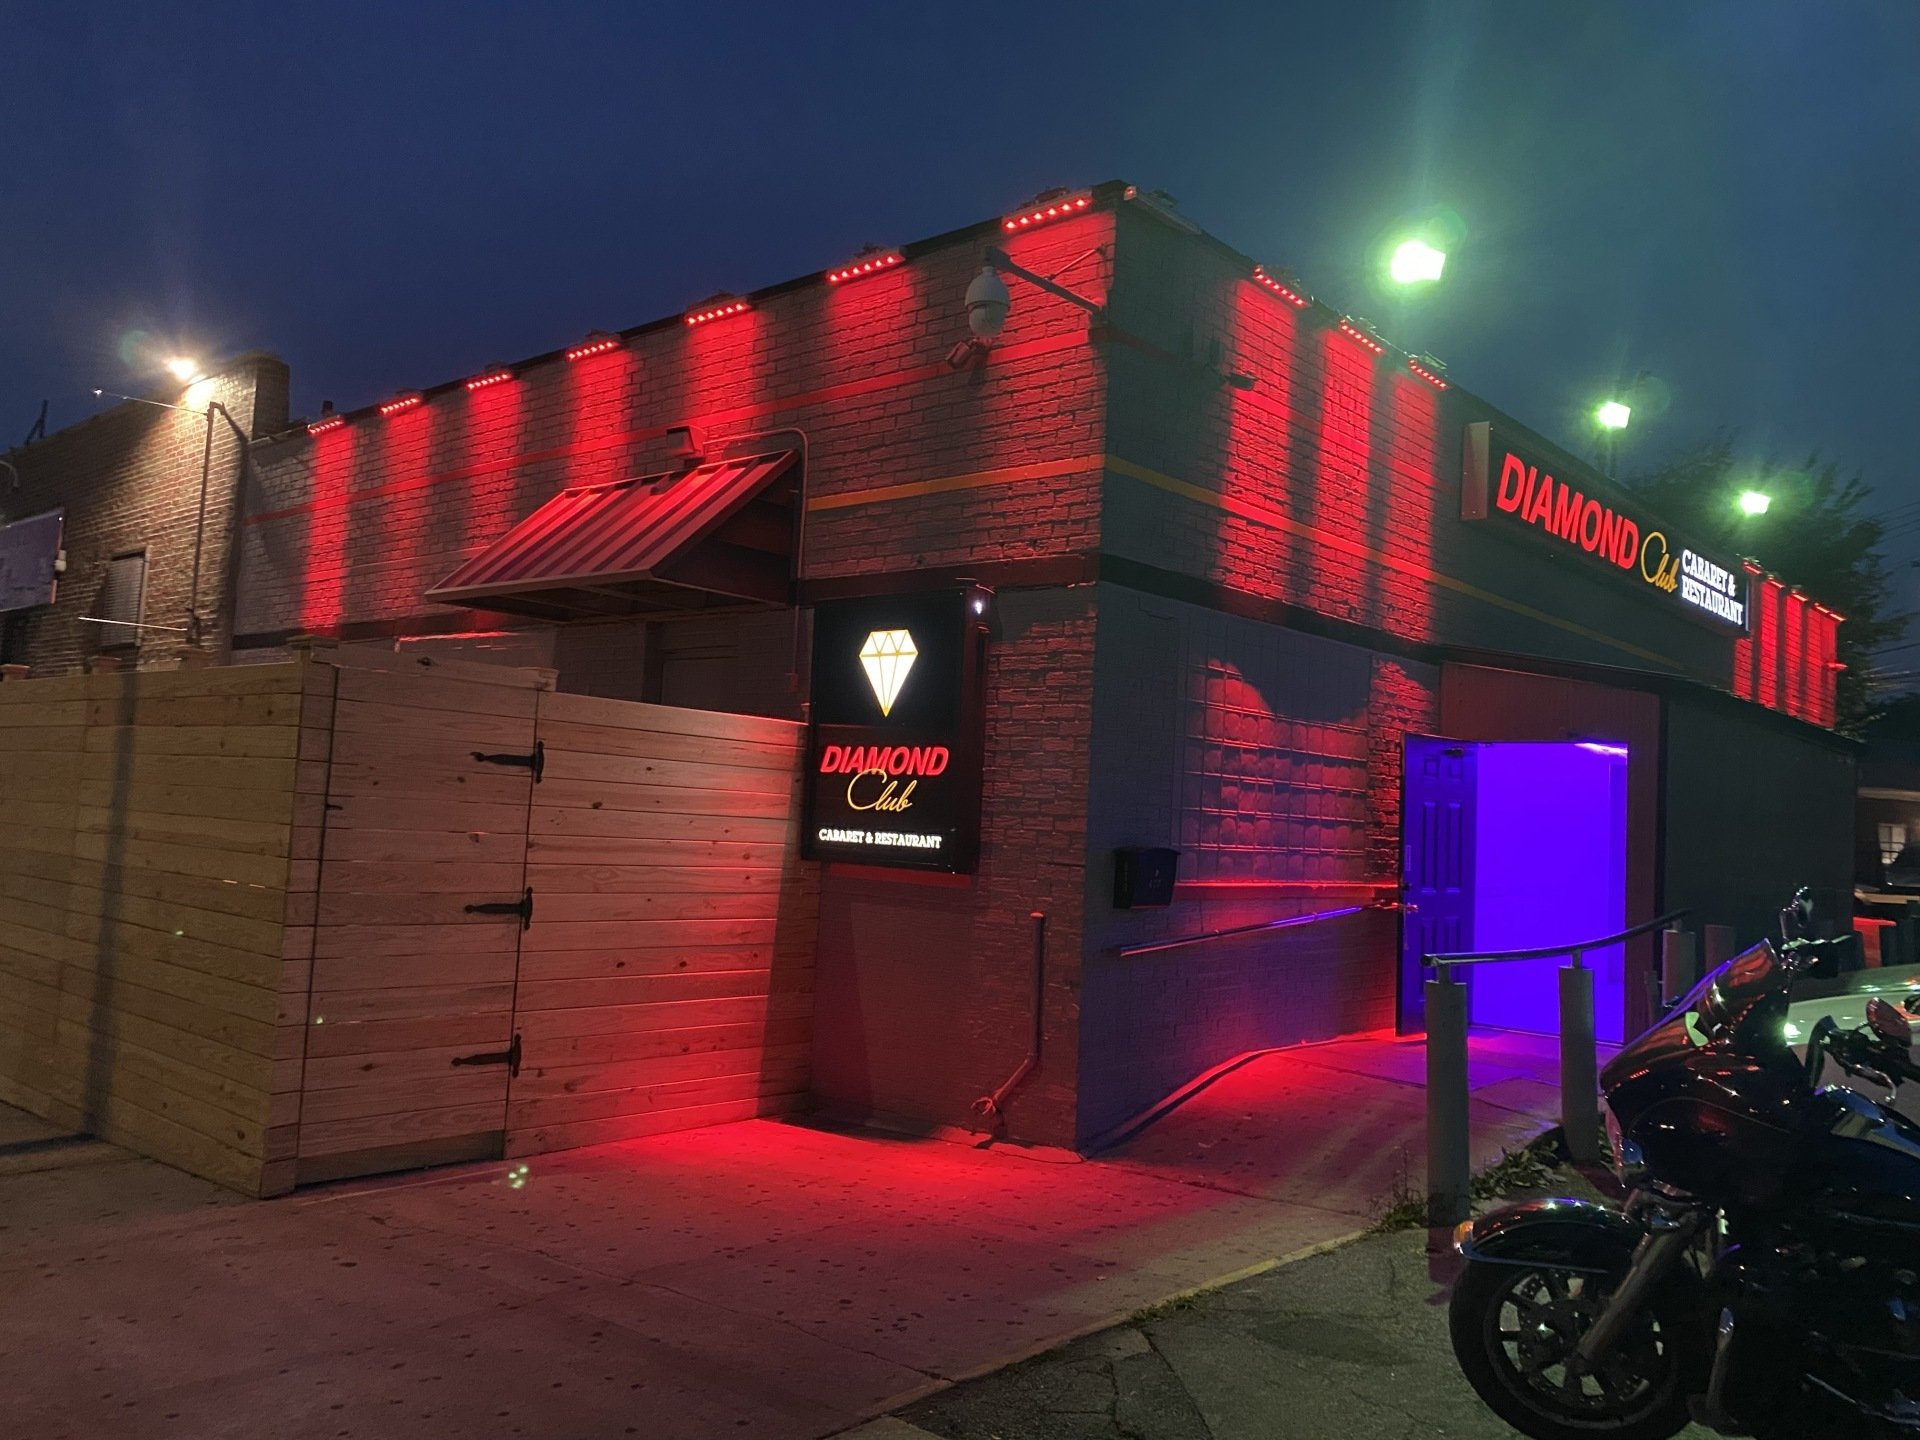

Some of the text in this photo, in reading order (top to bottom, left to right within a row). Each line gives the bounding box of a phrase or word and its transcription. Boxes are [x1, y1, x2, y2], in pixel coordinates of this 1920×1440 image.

[1496, 453, 1680, 593] DIAMOND Club
[1682, 549, 1736, 597] CABARET &
[1682, 575, 1743, 625] RESTAURANT
[820, 745, 949, 776] DIAMOND
[847, 768, 918, 812] Club
[818, 828, 942, 849] CABARET & RESTAURANT
